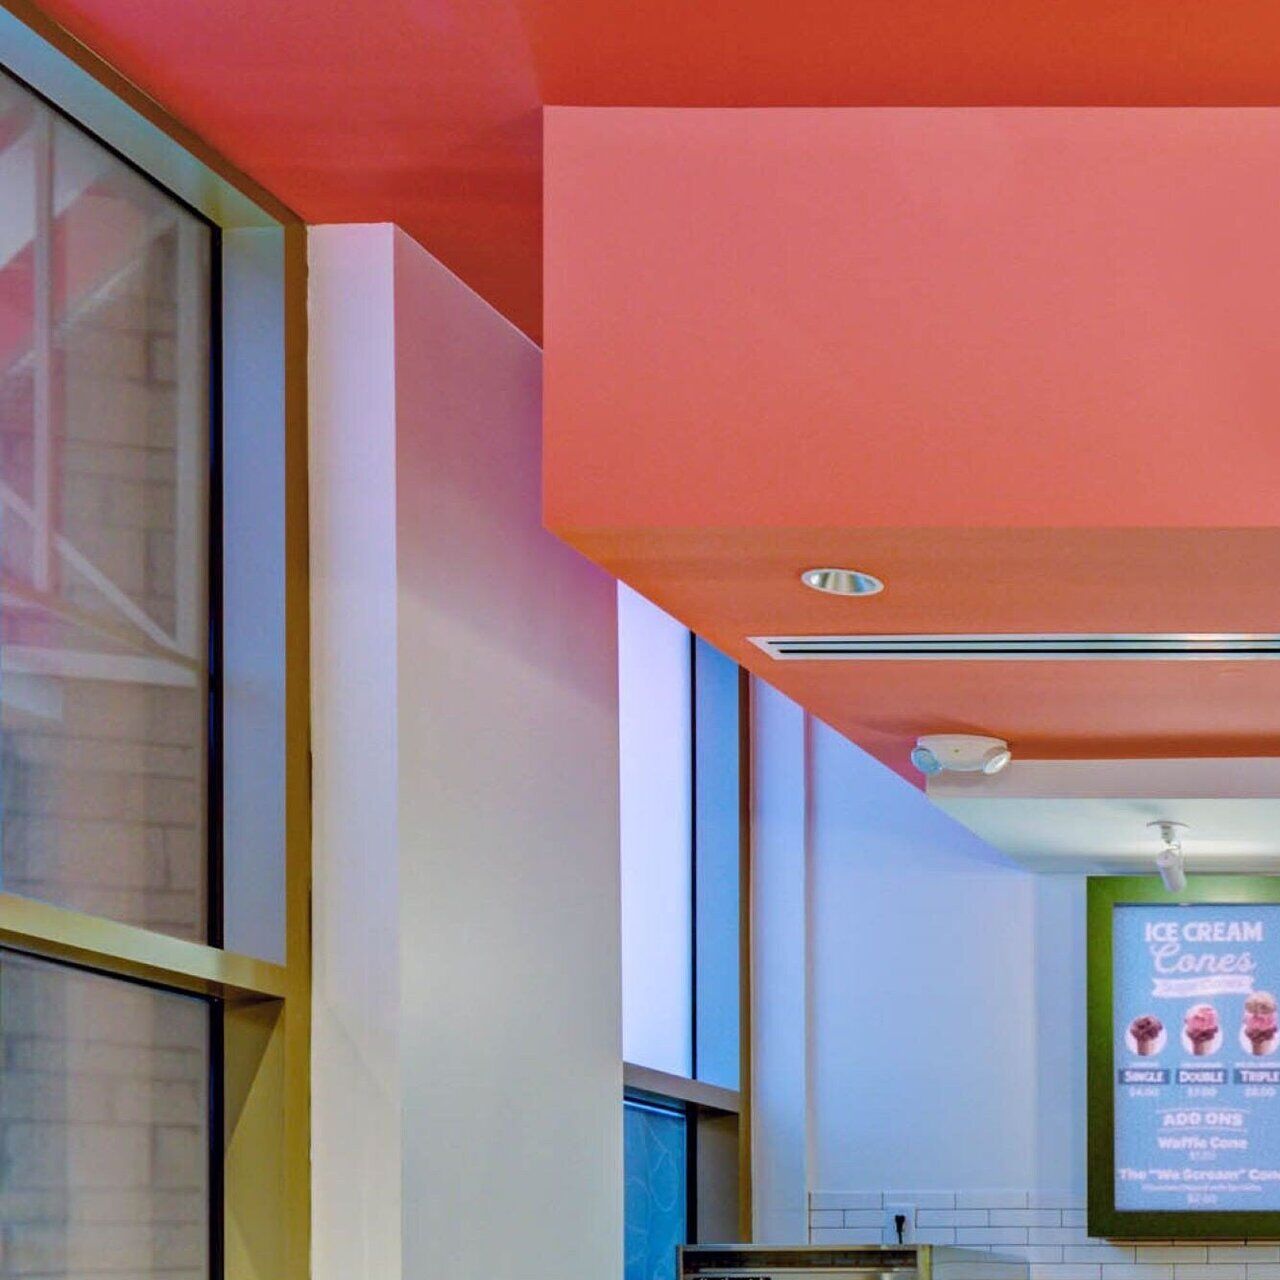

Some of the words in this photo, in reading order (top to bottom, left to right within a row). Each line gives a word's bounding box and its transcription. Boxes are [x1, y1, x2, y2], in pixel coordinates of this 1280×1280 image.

[1145, 922, 1179, 941] ICE
[1183, 922, 1263, 941] CREAM
[1150, 943, 1257, 973] Cones
[1125, 1071, 1163, 1082] SINGLE
[1180, 1071, 1224, 1083] DOUBLE
[1240, 1071, 1280, 1082] TRIPLE
[1163, 1113, 1200, 1126] ADD
[1206, 1113, 1243, 1126] ONS
[1158, 1137, 1207, 1149] Waffle
[1210, 1137, 1248, 1149] Cone
